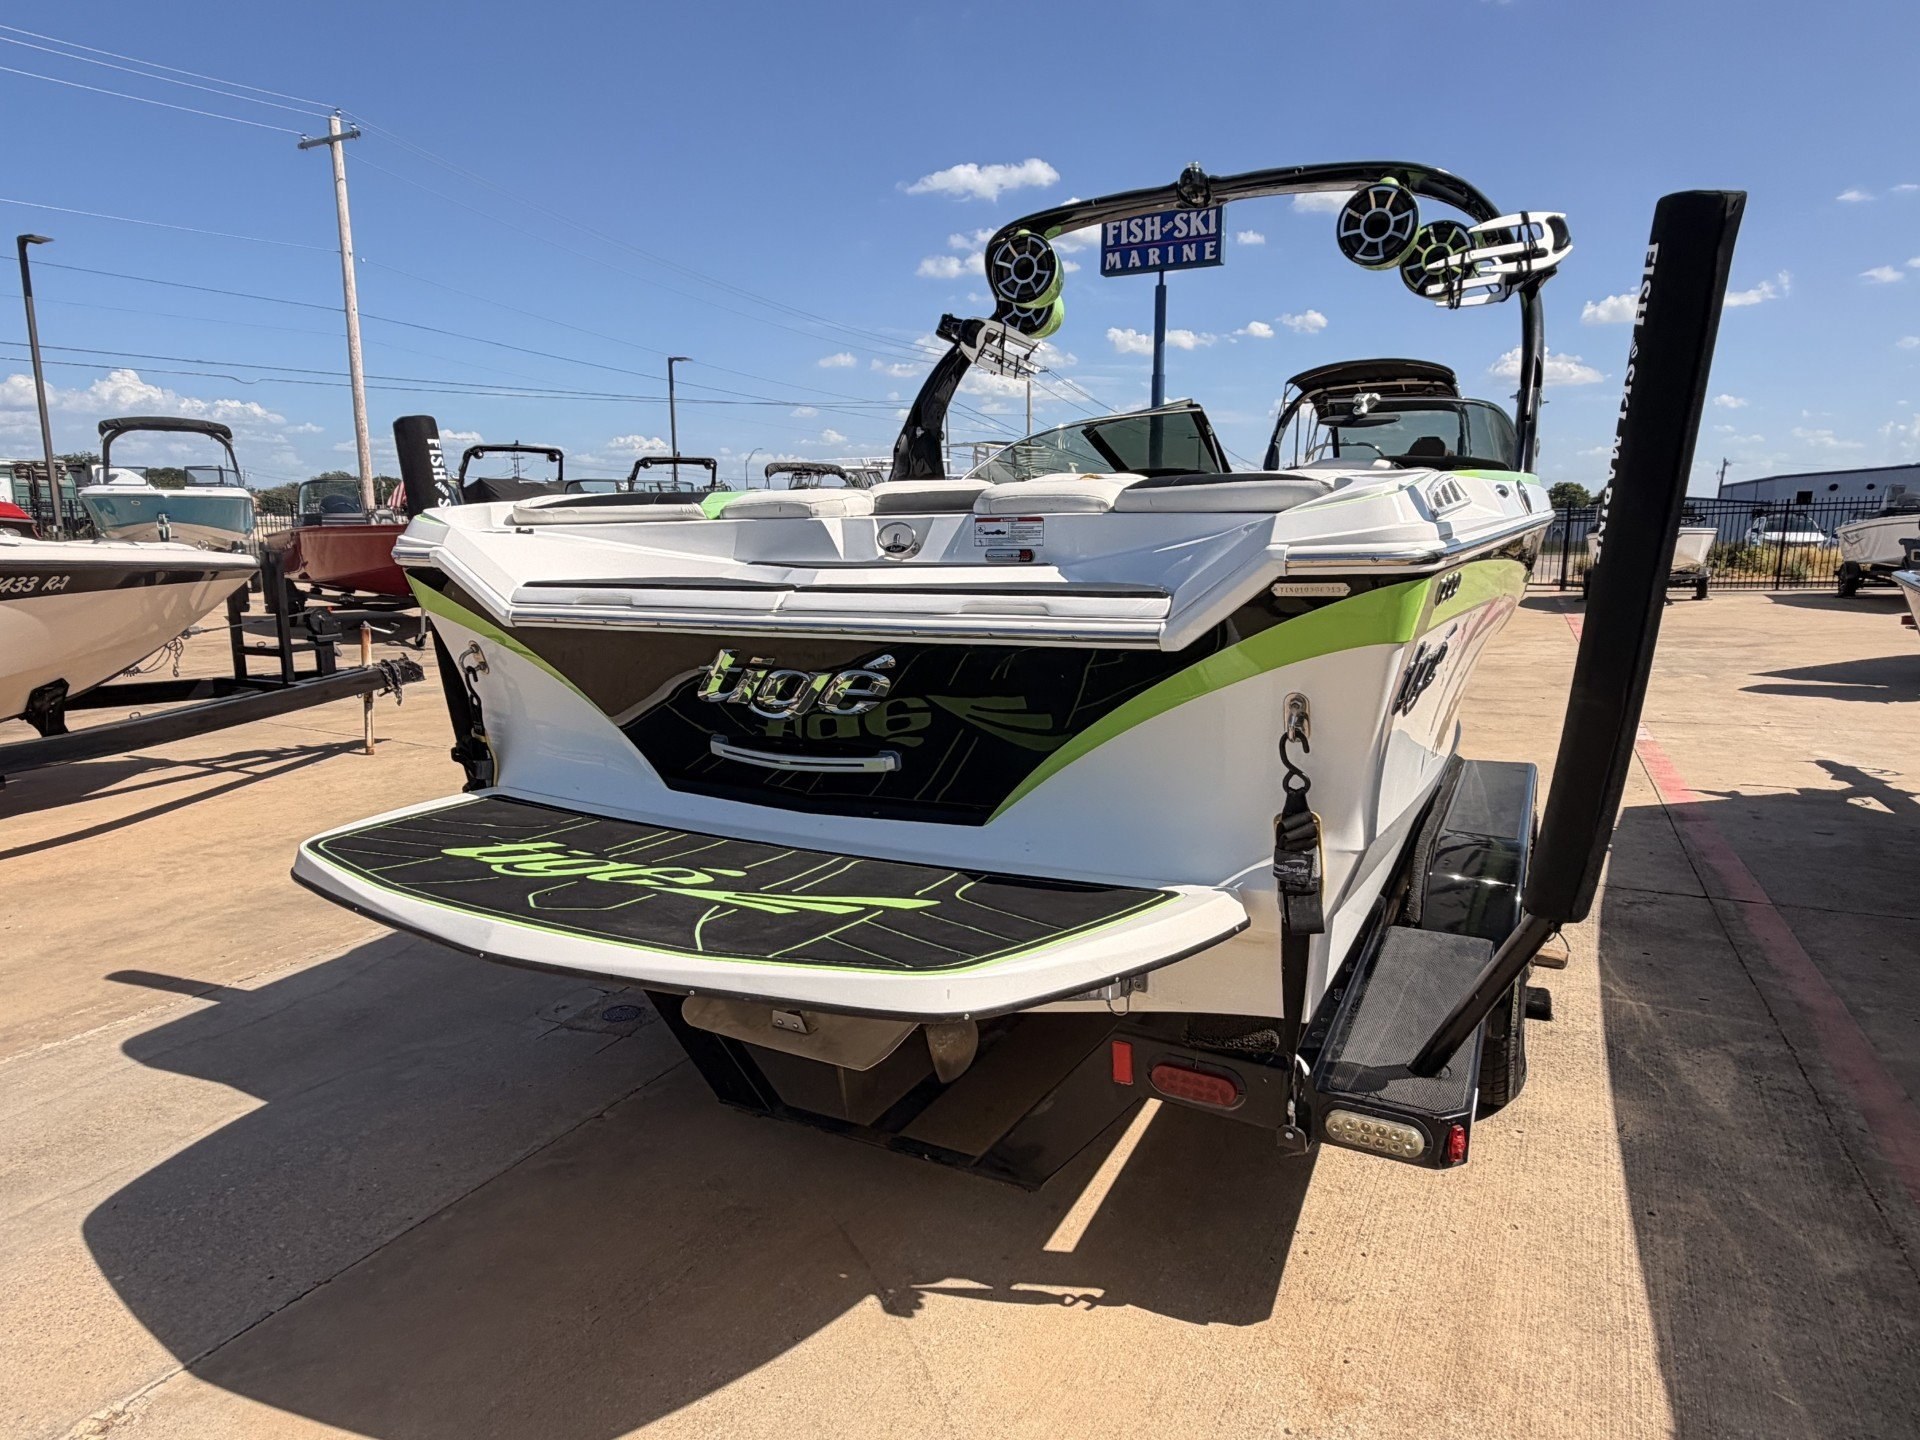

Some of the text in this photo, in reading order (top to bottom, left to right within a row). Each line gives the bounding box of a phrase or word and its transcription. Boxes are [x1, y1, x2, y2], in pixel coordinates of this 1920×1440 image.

[1106, 216, 1161, 246] FISH
[1173, 209, 1217, 238] SKI
[1105, 241, 1217, 270] MARINE
[427, 438, 447, 481] FISH
[0, 575, 71, 593] 433 RA
[697, 649, 896, 720] tigé
